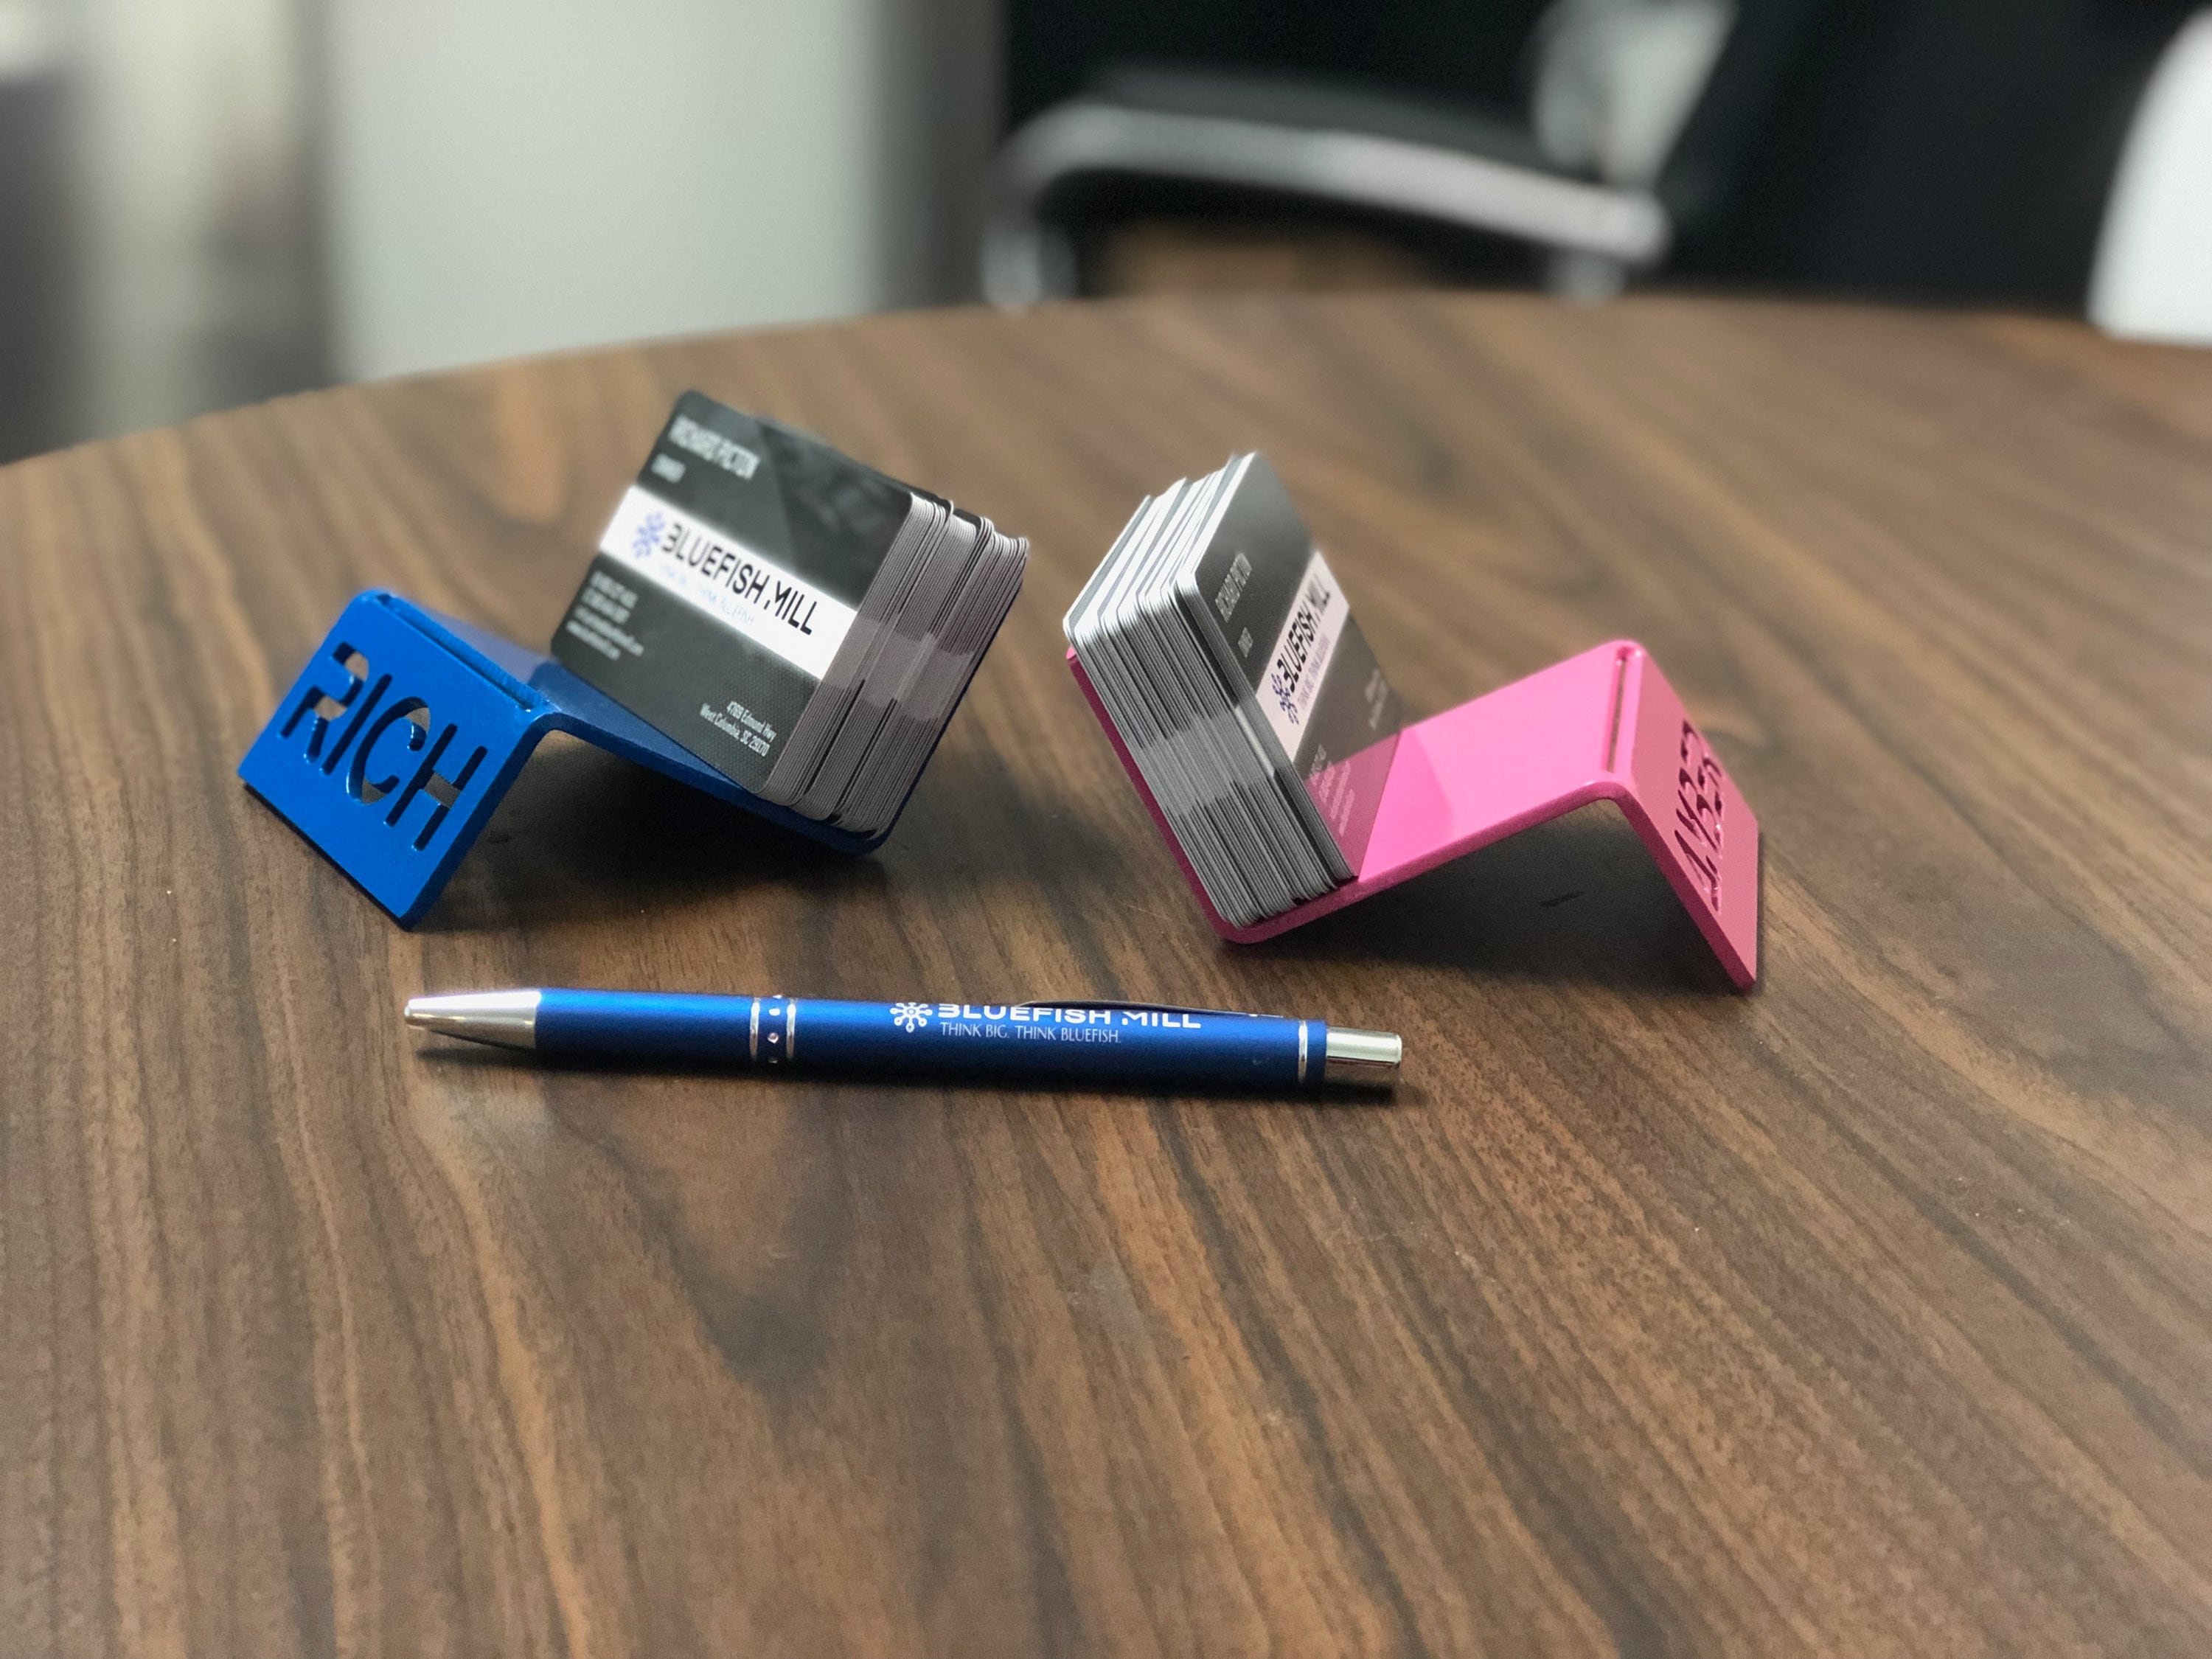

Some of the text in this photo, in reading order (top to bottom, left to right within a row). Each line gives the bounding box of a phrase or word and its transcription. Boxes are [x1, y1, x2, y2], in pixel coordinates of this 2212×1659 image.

[661, 523, 770, 604] BLUEFISH
[763, 580, 818, 636] MILL
[1277, 599, 1318, 693] BLUEFISH
[277, 641, 488, 852] RICH
[740, 729, 752, 745] SC
[748, 735, 771, 757] 29170
[762, 723, 777, 742] Hwy
[938, 1003, 1202, 1029] BLUEFISH MILL
[940, 1022, 1122, 1044] THINK BIG. THINK BLUEFISH.
